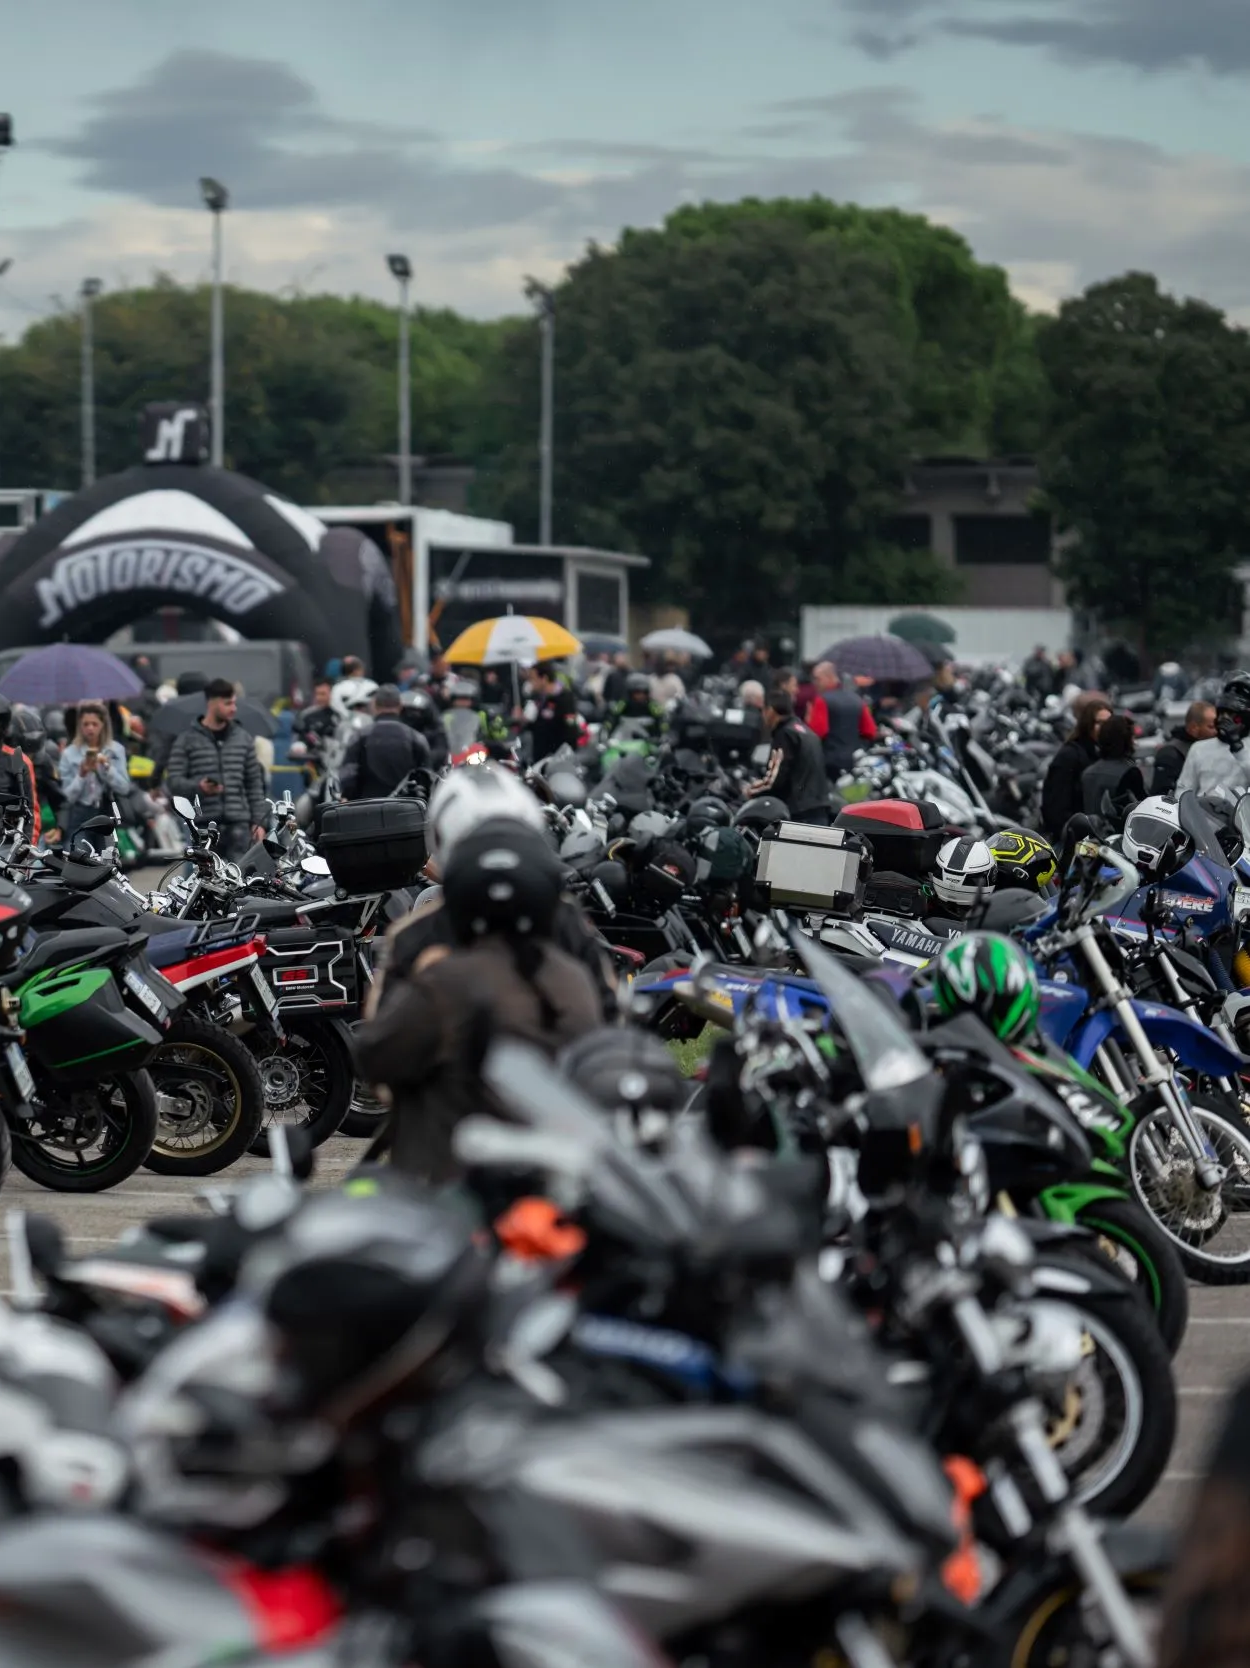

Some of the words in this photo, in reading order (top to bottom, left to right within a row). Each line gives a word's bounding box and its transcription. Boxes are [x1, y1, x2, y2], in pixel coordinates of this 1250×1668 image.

[36, 539, 285, 627] MOTORISMO
[891, 928, 942, 955] YAMAHA
[282, 969, 308, 981] GS
